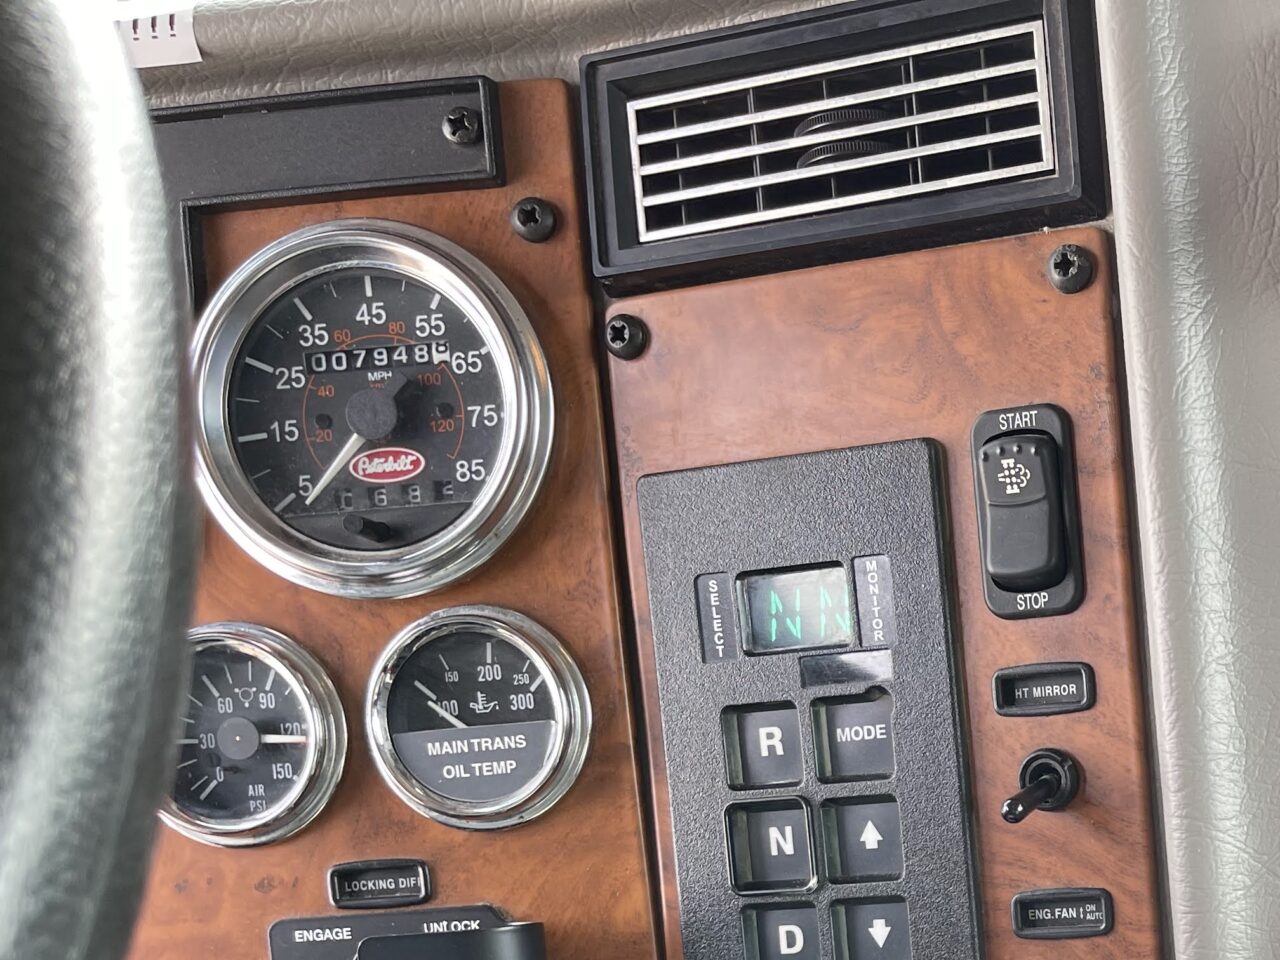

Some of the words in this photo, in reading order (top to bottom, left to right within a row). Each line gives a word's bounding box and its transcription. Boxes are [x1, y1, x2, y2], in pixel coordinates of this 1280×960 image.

[356, 302, 386, 325] 45
[388, 321, 405, 335] 80
[415, 314, 445, 337] 55
[299, 324, 329, 346] 35
[333, 329, 350, 343] 60
[451, 351, 482, 374] 65
[275, 367, 305, 389] 25
[367, 371, 392, 382] MPH
[417, 373, 441, 386] 100
[317, 385, 335, 398] 40
[467, 405, 497, 427] 75
[999, 411, 1038, 430] START
[270, 419, 299, 442] 15
[430, 419, 454, 432] 120
[315, 429, 332, 442] 20
[358, 456, 418, 475] Peterbilt
[455, 459, 486, 482] 85
[298, 475, 312, 496] 5
[866, 560, 884, 642] MONITOR
[1017, 593, 1048, 610] STOP
[708, 579, 724, 658] SELECT
[445, 671, 459, 683] 150
[477, 664, 501, 682] 200
[513, 673, 530, 685] 250
[1014, 688, 1029, 699] HT
[1032, 684, 1077, 698] MIRROR
[217, 698, 233, 714] 60
[259, 693, 275, 709] 90
[510, 693, 534, 710] 300
[200, 734, 215, 749] 30
[758, 726, 785, 757] R
[836, 724, 887, 742] MODE
[427, 740, 469, 756] MAIN
[471, 735, 526, 751] TRANS
[216, 766, 224, 782] 0
[272, 763, 292, 779] 150
[443, 764, 470, 779] OIL
[472, 760, 517, 776] TEMP
[248, 785, 265, 797] AIR
[250, 800, 266, 812] PSI
[768, 825, 795, 856] N
[345, 879, 396, 892] LOCKING
[1085, 904, 1096, 912] ON
[294, 928, 352, 942] ENGAGE
[778, 924, 804, 955] D
